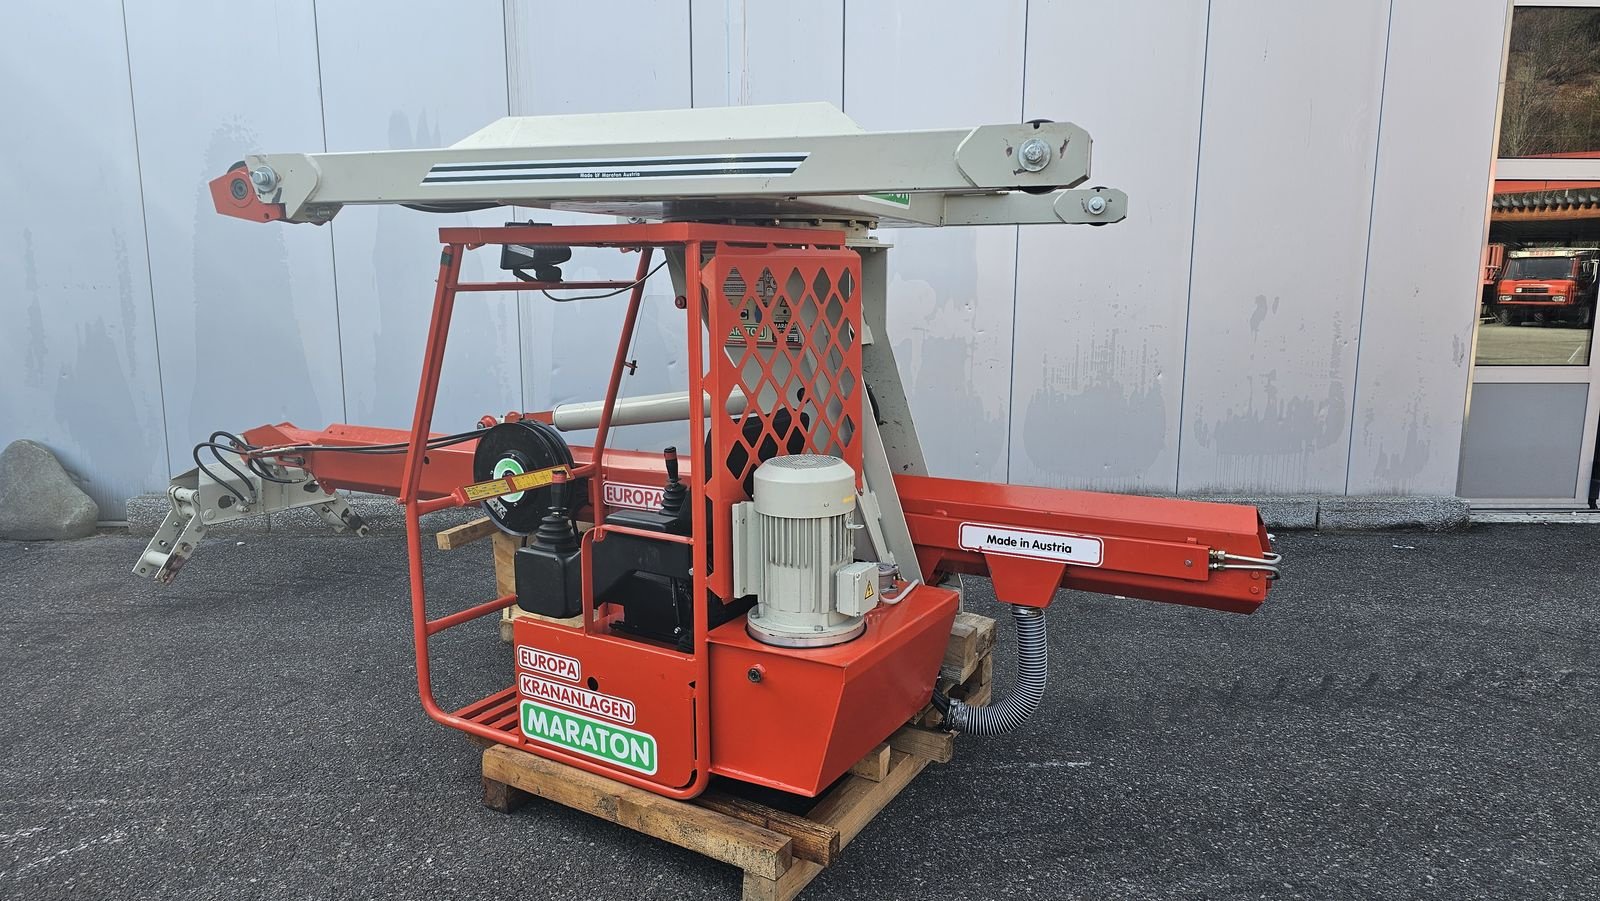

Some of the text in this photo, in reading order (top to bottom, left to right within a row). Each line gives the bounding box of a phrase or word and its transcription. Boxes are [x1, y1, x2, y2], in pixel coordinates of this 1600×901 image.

[606, 486, 662, 506] EUROPA
[986, 534, 1072, 554] Made in Austria
[520, 650, 577, 677] EUROPA
[523, 677, 630, 720] KRANANLAGEN
[528, 708, 650, 767] MARATON
